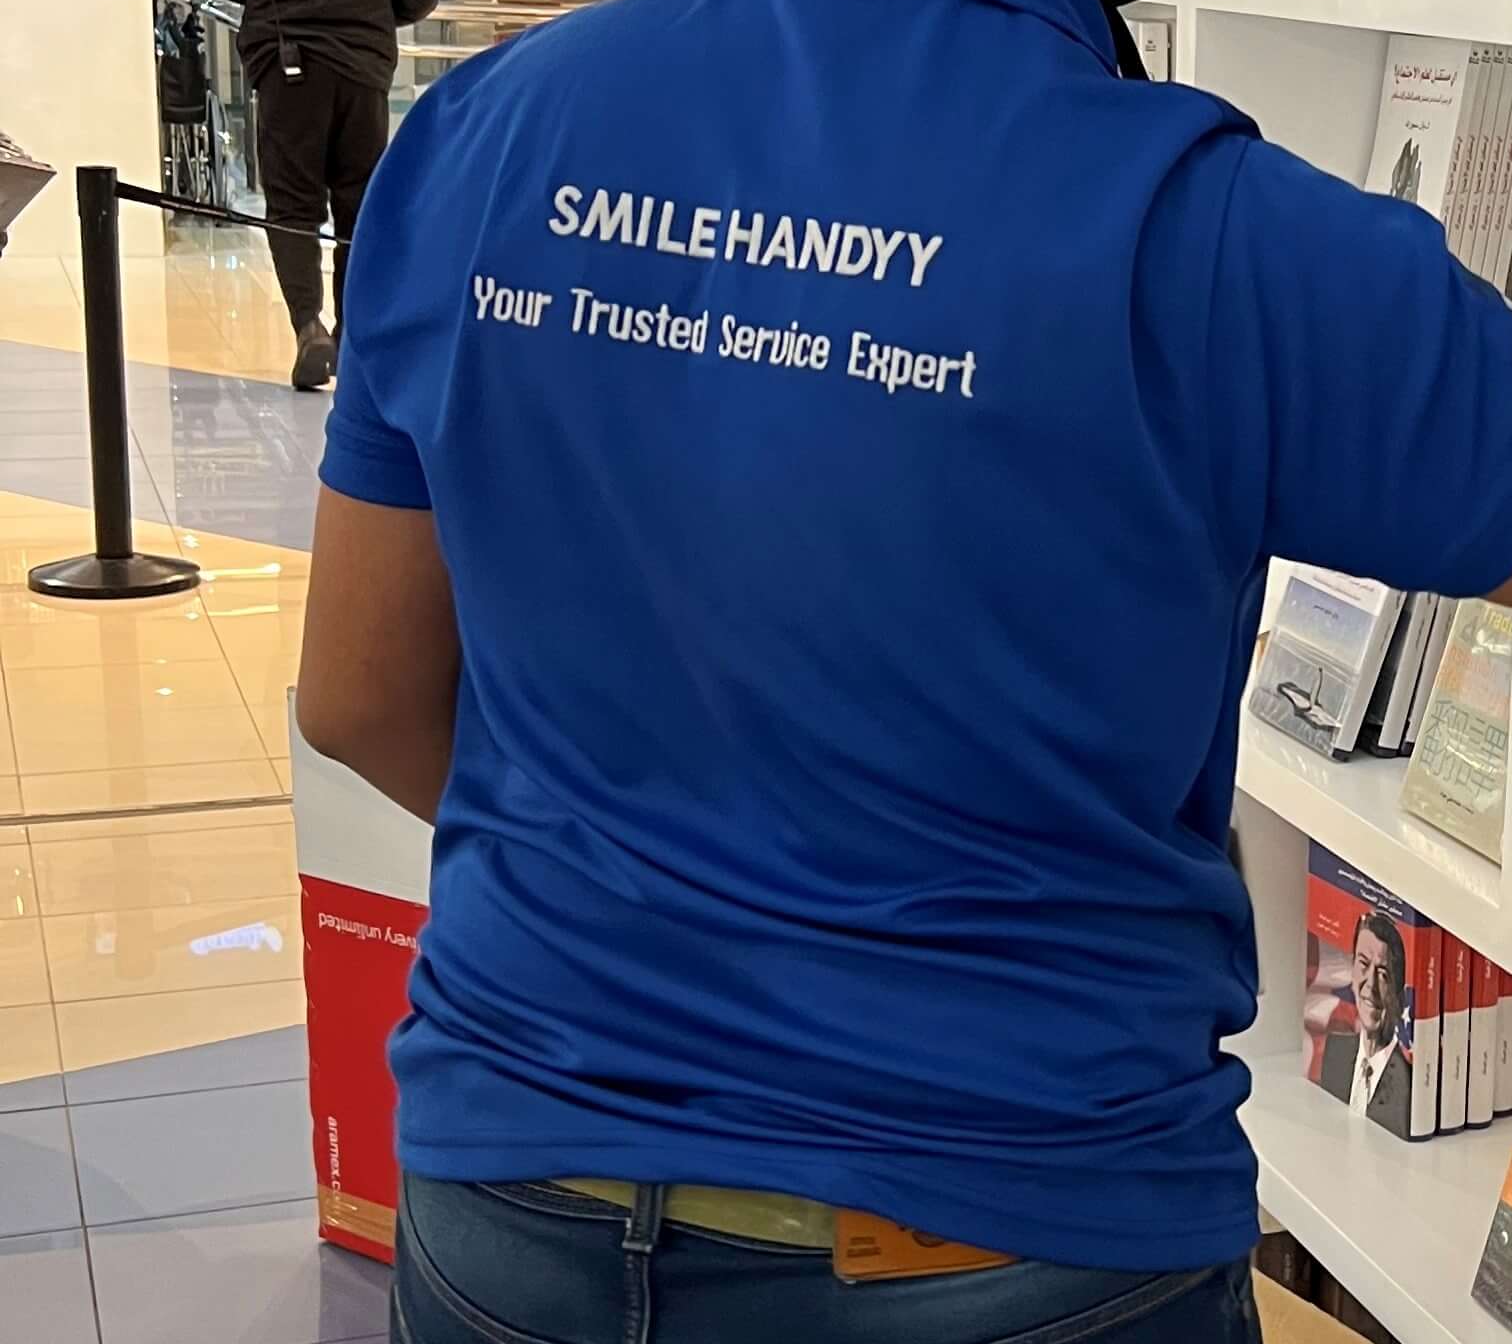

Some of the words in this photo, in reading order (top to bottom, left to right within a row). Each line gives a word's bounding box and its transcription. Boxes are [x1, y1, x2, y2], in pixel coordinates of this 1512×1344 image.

[548, 184, 943, 288] SMILEHANDYY
[473, 276, 552, 328] Your
[570, 287, 709, 355] Trusted
[718, 314, 831, 371] Service
[847, 333, 977, 399] Expert
[318, 912, 382, 941] unlimited
